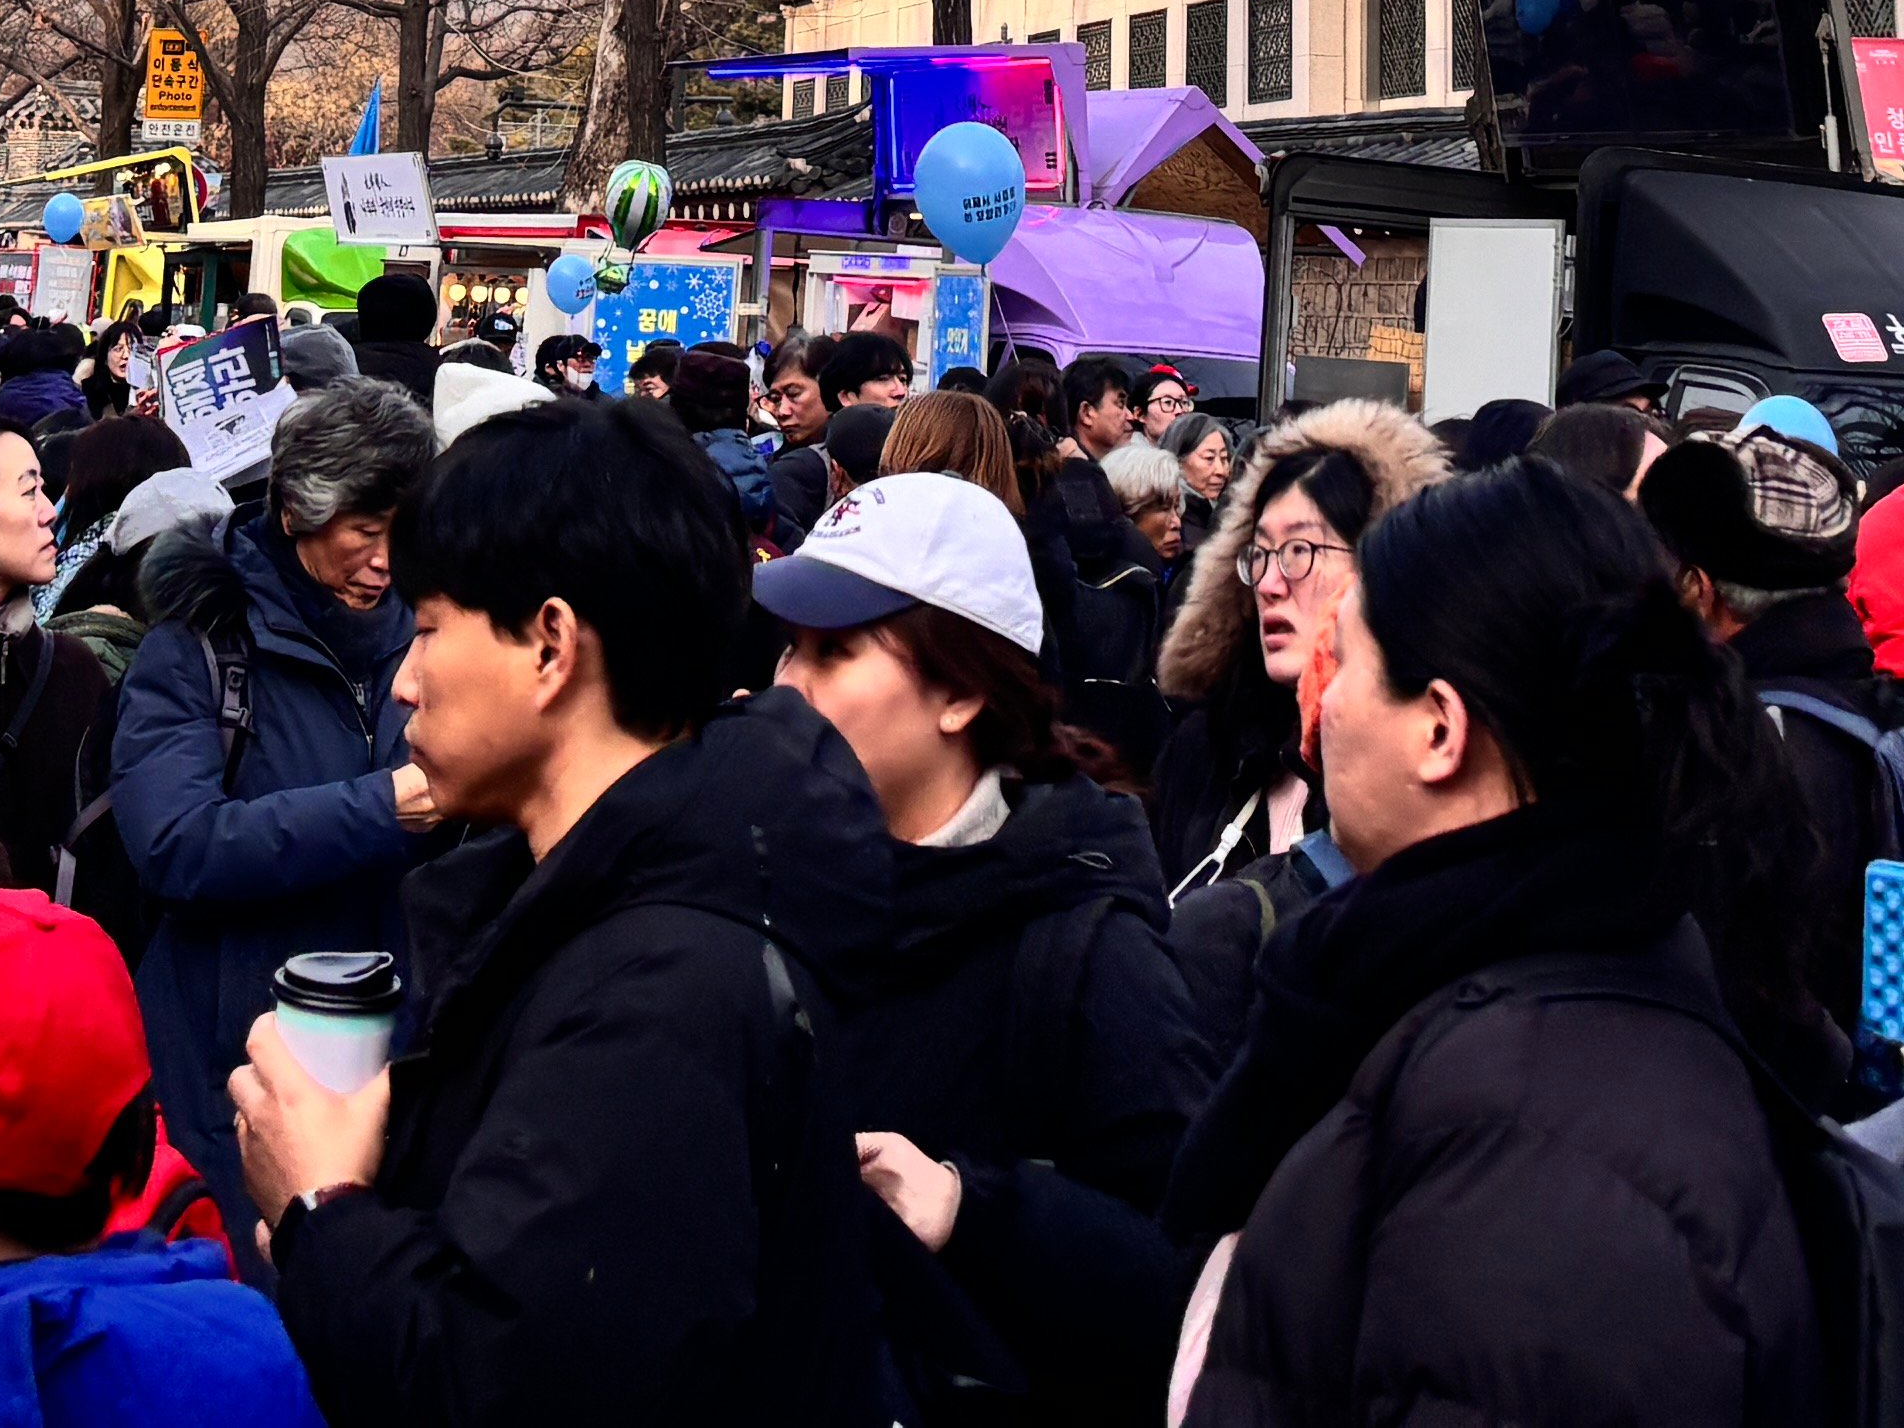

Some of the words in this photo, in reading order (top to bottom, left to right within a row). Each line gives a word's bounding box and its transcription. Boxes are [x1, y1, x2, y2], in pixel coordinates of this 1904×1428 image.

[152, 74, 199, 89] 단속구간
[158, 90, 193, 101] Photo
[1873, 132, 1894, 154] 민
